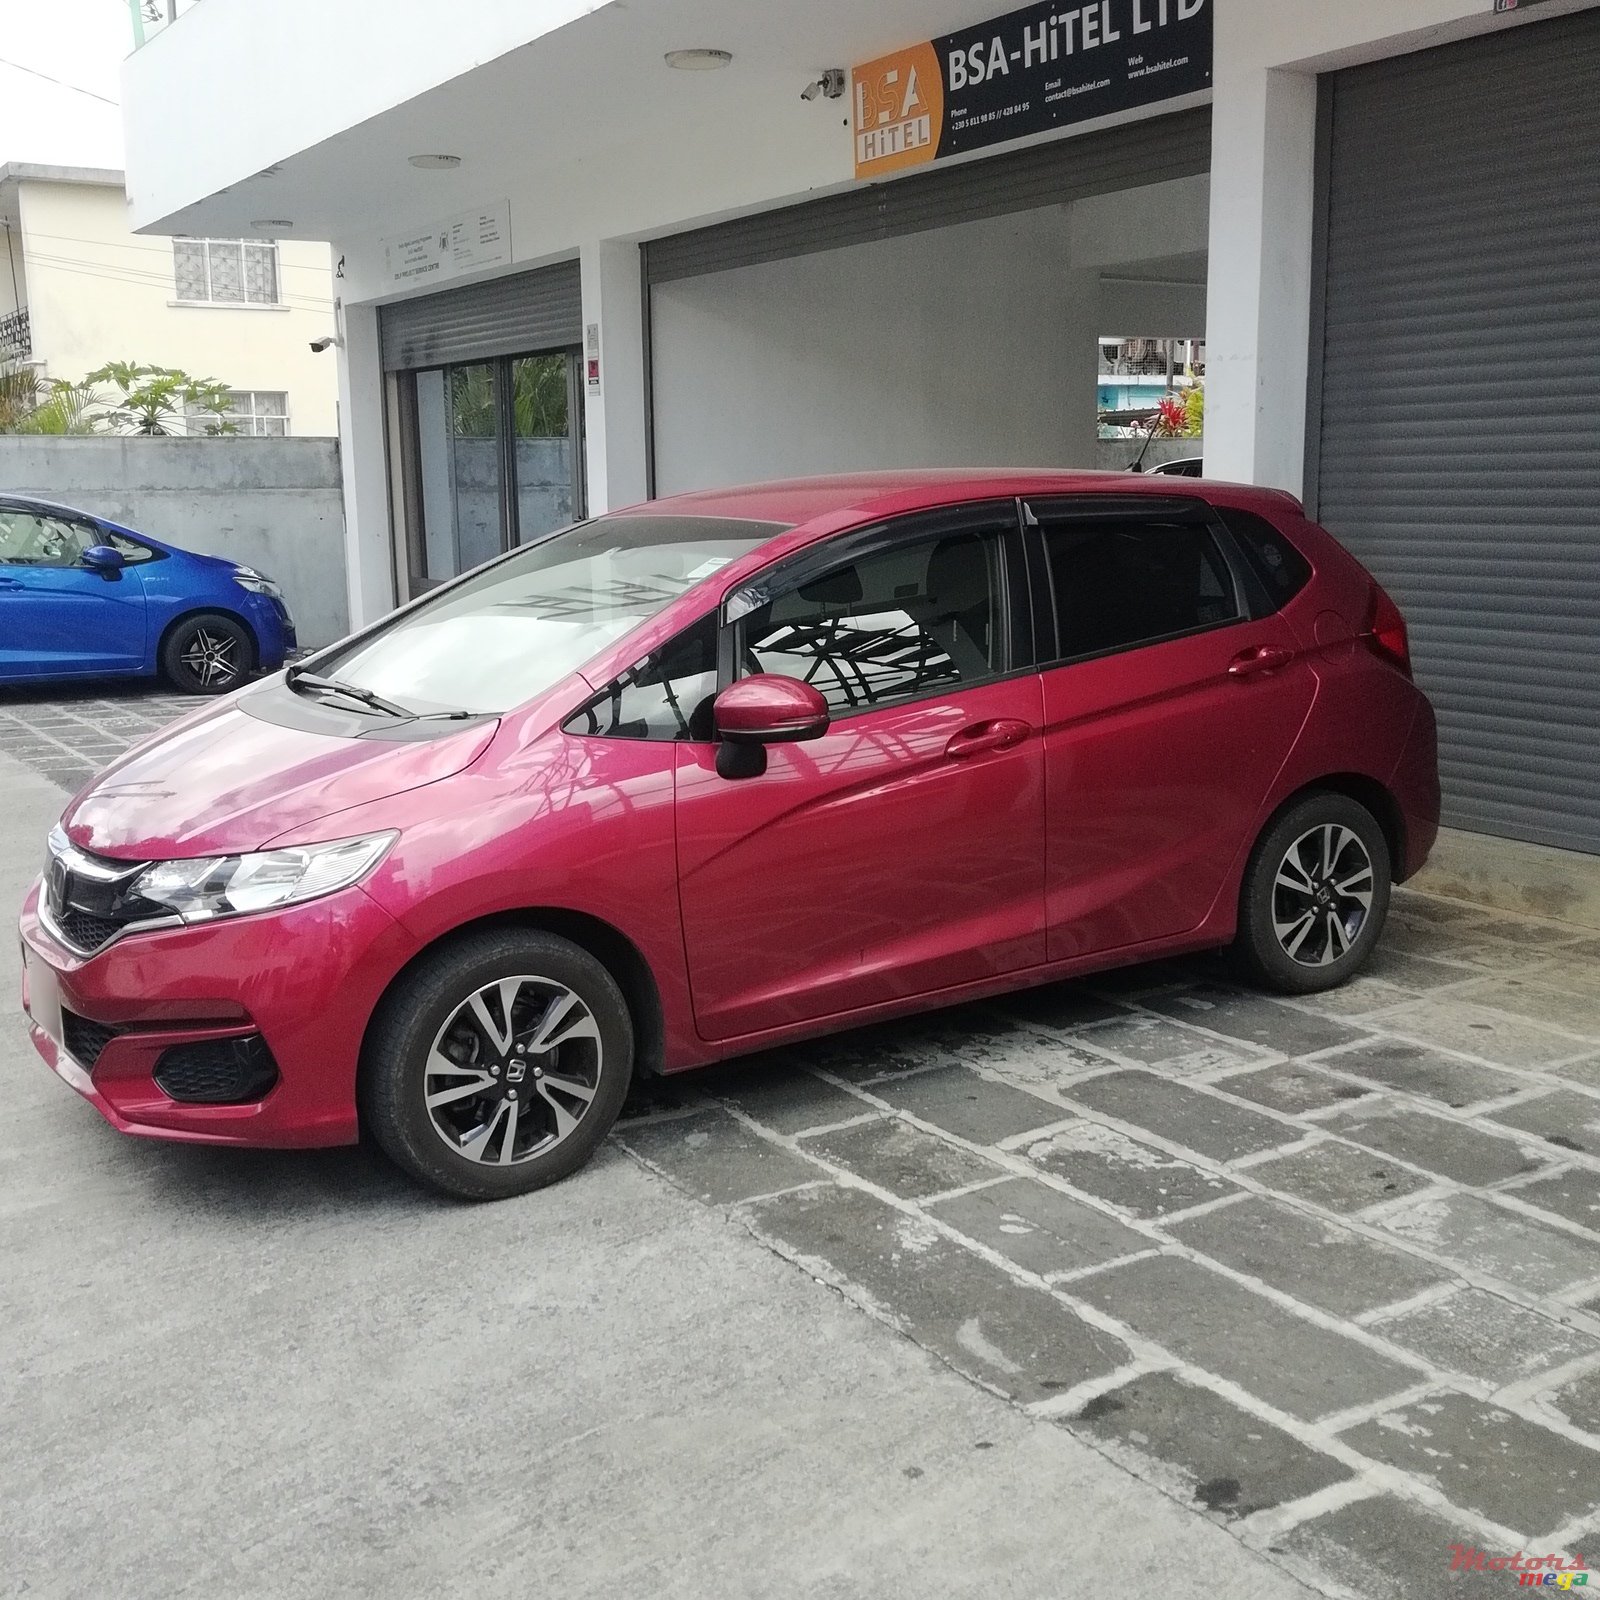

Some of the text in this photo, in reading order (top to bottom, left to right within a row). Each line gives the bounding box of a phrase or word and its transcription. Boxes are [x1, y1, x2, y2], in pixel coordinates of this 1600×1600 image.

[949, 0, 1120, 91] BSA-HiTEL
[1127, 55, 1144, 66] Web
[1127, 56, 1189, 79] www.bsahitel.com
[1044, 78, 1061, 91] Email
[1044, 78, 1111, 103] contact@bsahitel.com
[856, 64, 929, 131] BSA
[950, 107, 968, 118] Phone
[951, 119, 965, 131] +230
[864, 118, 928, 159] HiTEL
